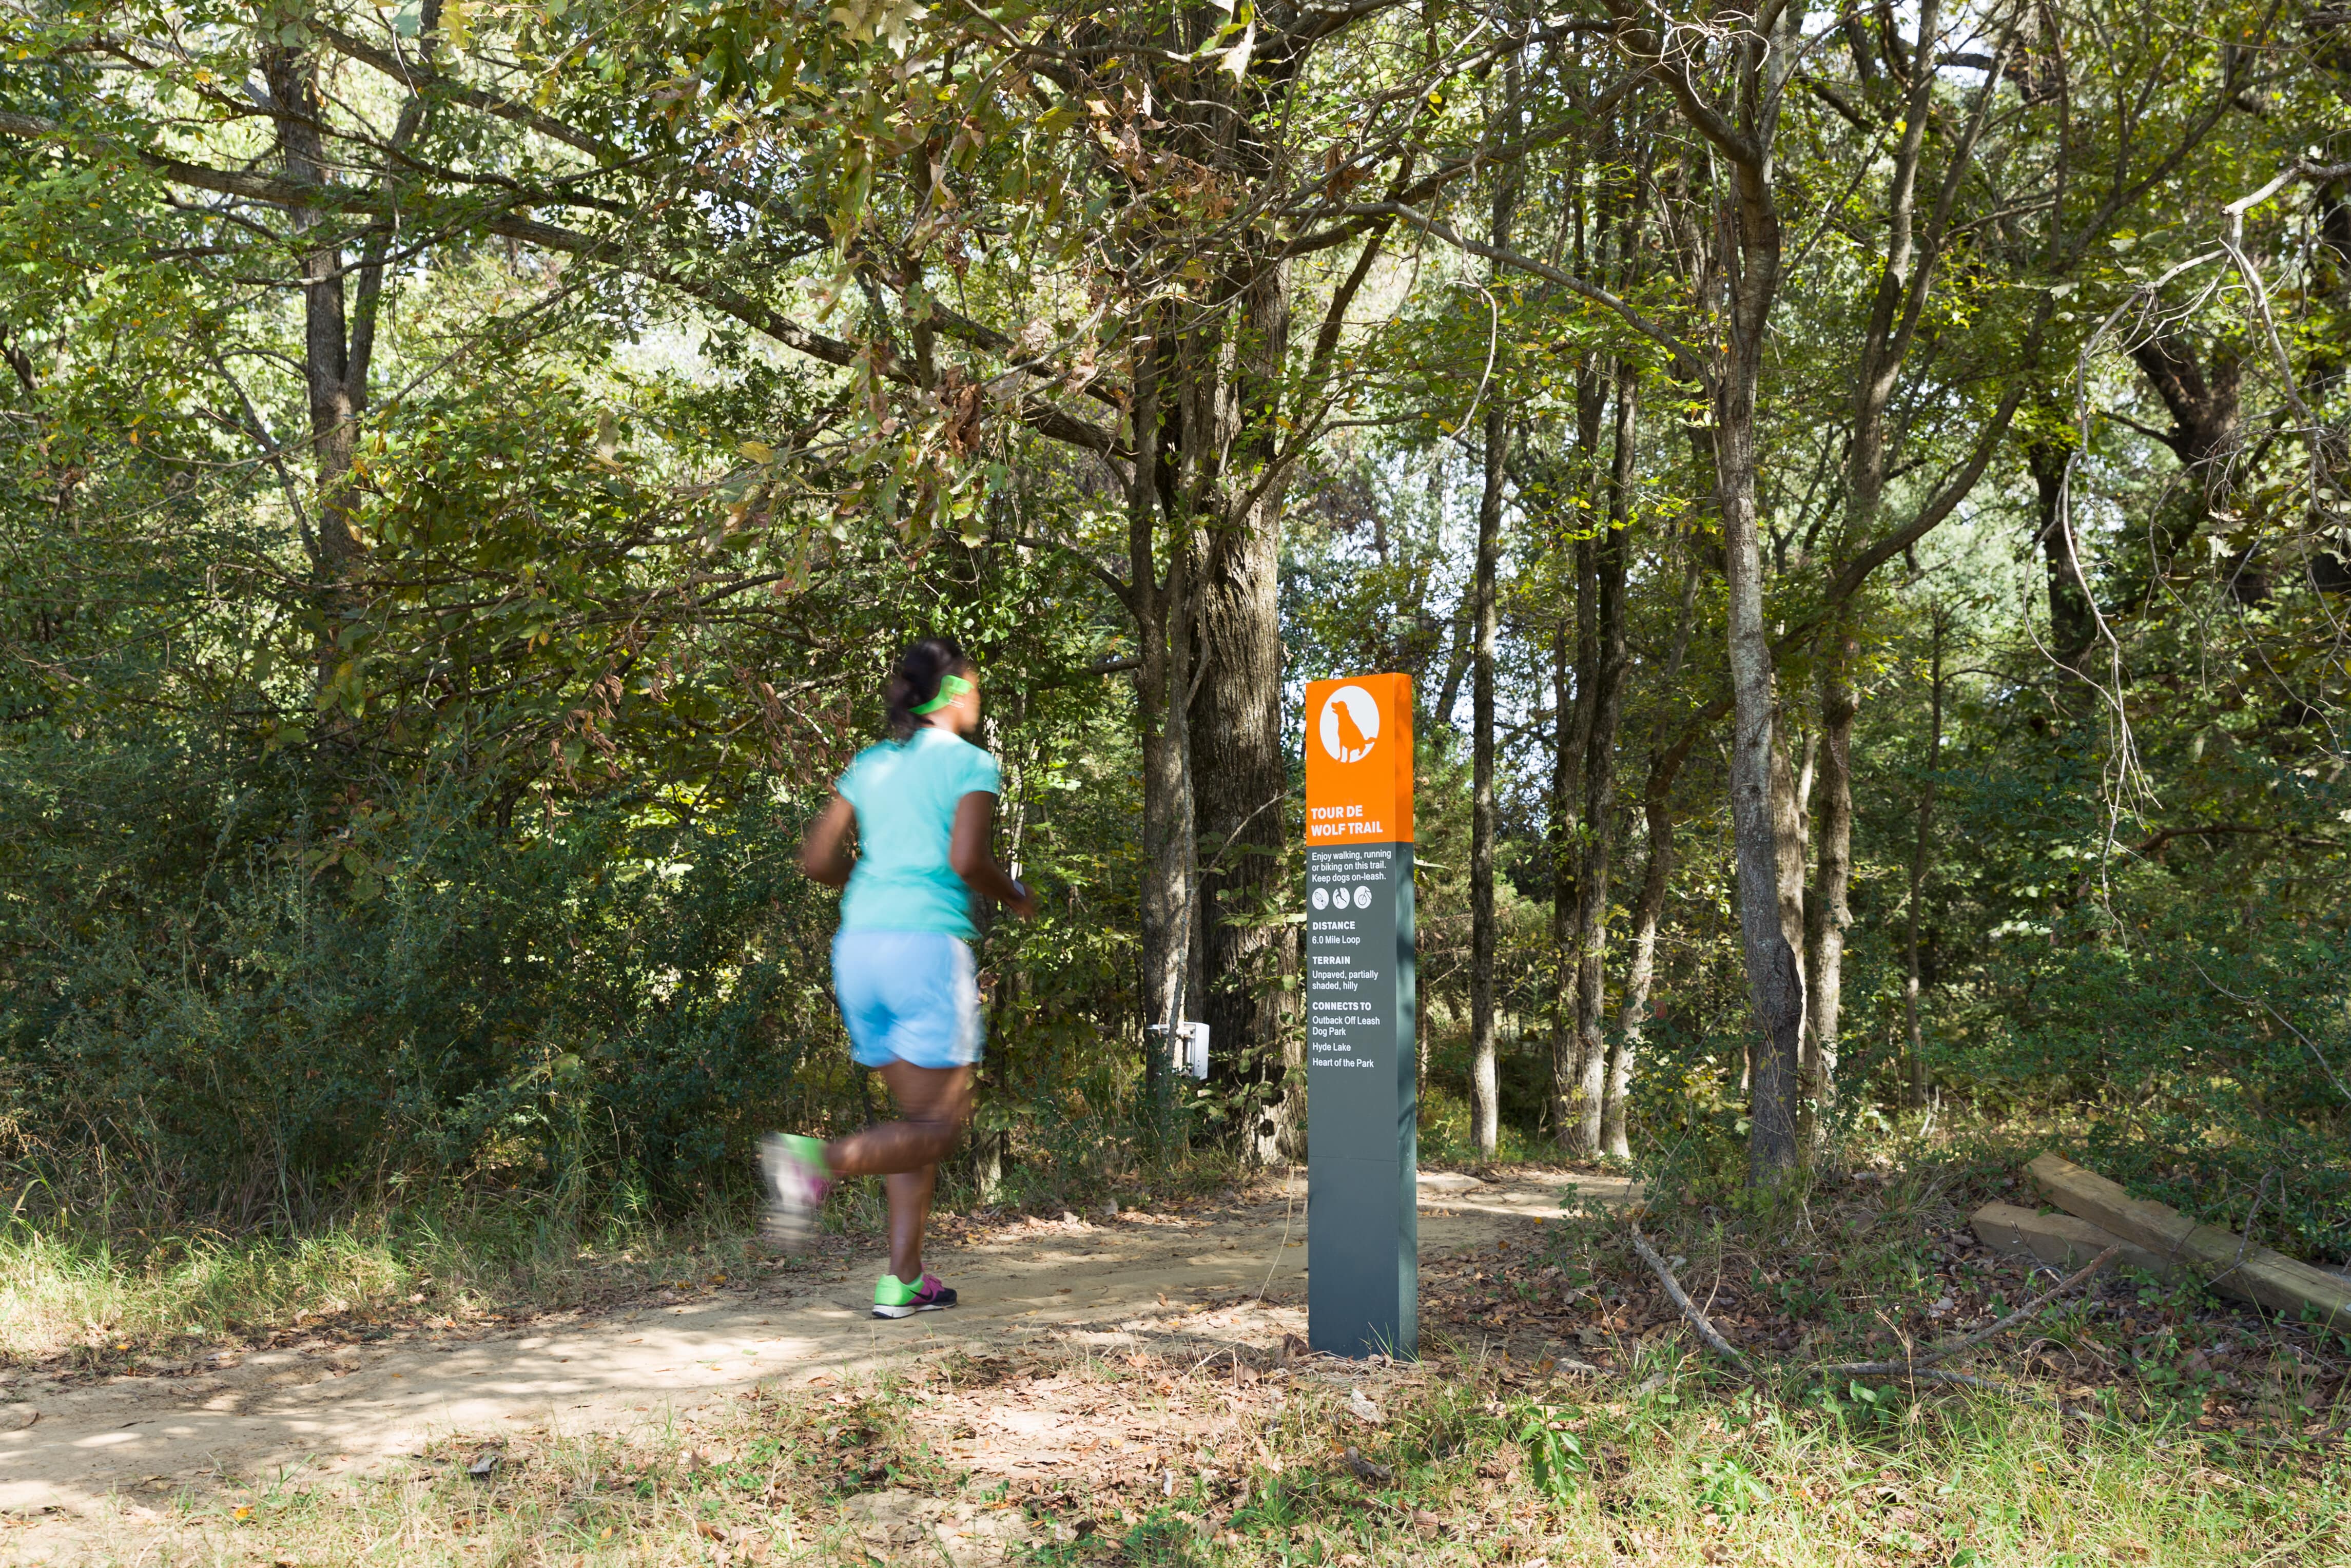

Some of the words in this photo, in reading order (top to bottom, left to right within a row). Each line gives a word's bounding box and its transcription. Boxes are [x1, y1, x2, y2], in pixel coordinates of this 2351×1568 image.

[1311, 806, 1344, 820] TOUR
[1346, 805, 1363, 818] DE
[1311, 823, 1346, 837] WOLF
[1348, 821, 1383, 834] TRAIL
[1312, 851, 1332, 861] Enjoy
[1333, 850, 1363, 860] walking,
[1364, 849, 1392, 859] running
[1320, 862, 1343, 872] biking
[1370, 861, 1386, 869] trail.
[1312, 874, 1331, 884] Keep
[1332, 873, 1350, 883] dogs
[1351, 872, 1386, 881] on-leash.
[1312, 921, 1355, 930] DISTANCE
[1312, 936, 1324, 944] 6.0
[1325, 935, 1340, 944] Mile
[1342, 935, 1361, 945] Loop
[1312, 956, 1351, 964] TERRAIN
[1312, 970, 1347, 980] Unpaved,
[1349, 970, 1378, 980] partially
[1312, 981, 1341, 991] shaded,
[1343, 981, 1358, 992] hilly
[1312, 1001, 1358, 1011] CONNECTS
[1360, 1002, 1372, 1011] TO
[1312, 1016, 1343, 1024] Outback
[1344, 1016, 1356, 1024] Off
[1357, 1016, 1380, 1025] Leash
[1312, 1027, 1327, 1037] Dog
[1329, 1027, 1346, 1036] Park
[1312, 1042, 1331, 1052] Hyde
[1333, 1042, 1351, 1052] Lake
[1312, 1058, 1333, 1067] Heart
[1334, 1058, 1342, 1067] of
[1343, 1059, 1355, 1067] the
[1356, 1059, 1374, 1068] Park
